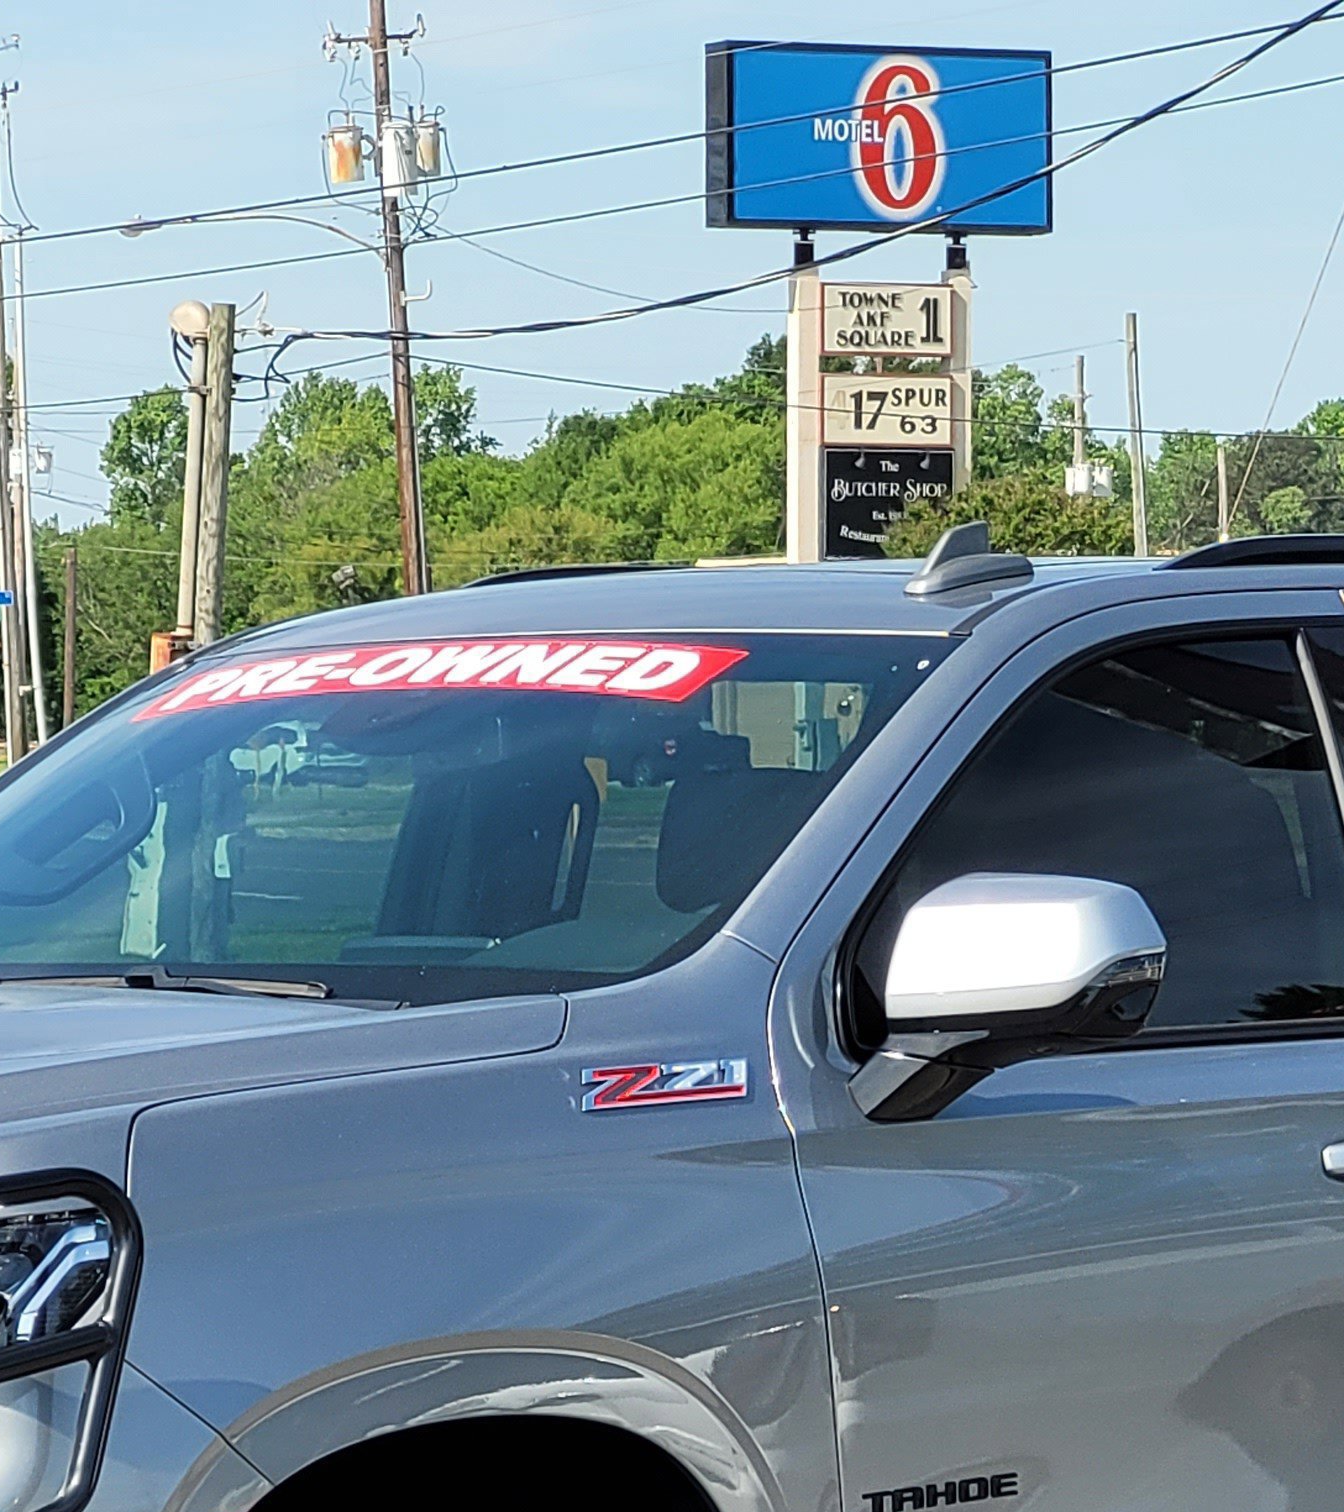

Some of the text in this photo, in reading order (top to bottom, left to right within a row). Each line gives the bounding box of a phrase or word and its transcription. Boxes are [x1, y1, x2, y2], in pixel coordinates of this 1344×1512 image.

[813, 61, 940, 213] MOTEL 6
[837, 291, 903, 309] TOWNE
[836, 330, 915, 348] SQUARE
[891, 387, 947, 408] SPUR
[899, 415, 938, 435] 63
[879, 460, 900, 473] The
[159, 644, 700, 711] PRE-OWNED
[581, 1058, 748, 1112] Z71
